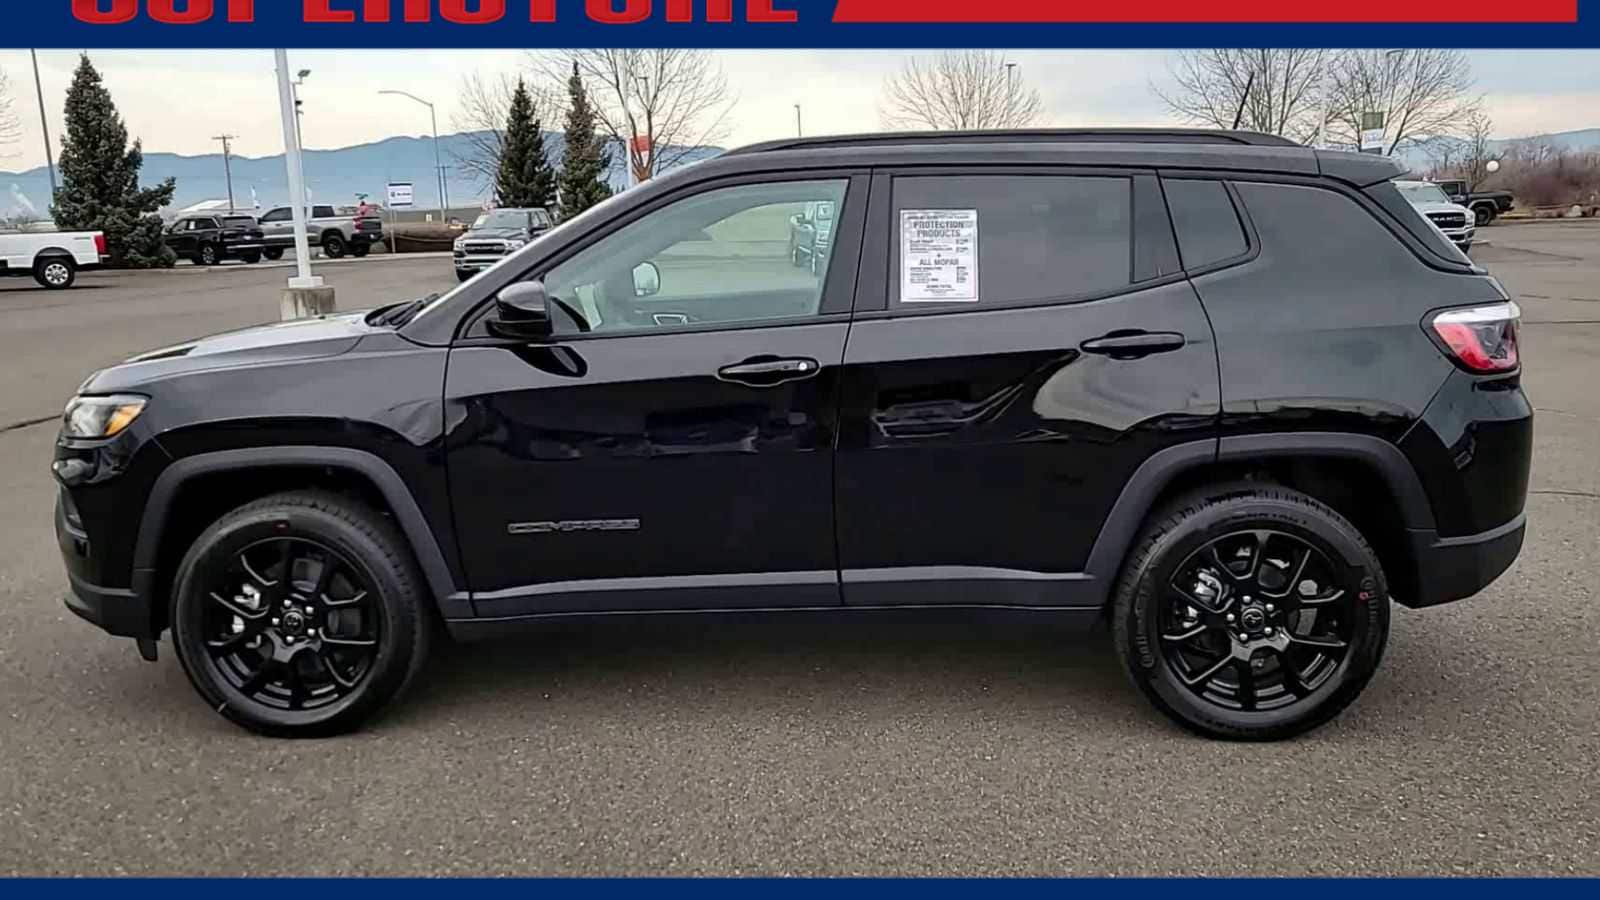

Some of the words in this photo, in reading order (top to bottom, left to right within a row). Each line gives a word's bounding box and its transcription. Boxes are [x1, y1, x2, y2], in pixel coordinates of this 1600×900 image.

[913, 221, 964, 229] PROTECTION
[917, 230, 961, 238] PRODUCTS
[919, 258, 932, 266] ALL
